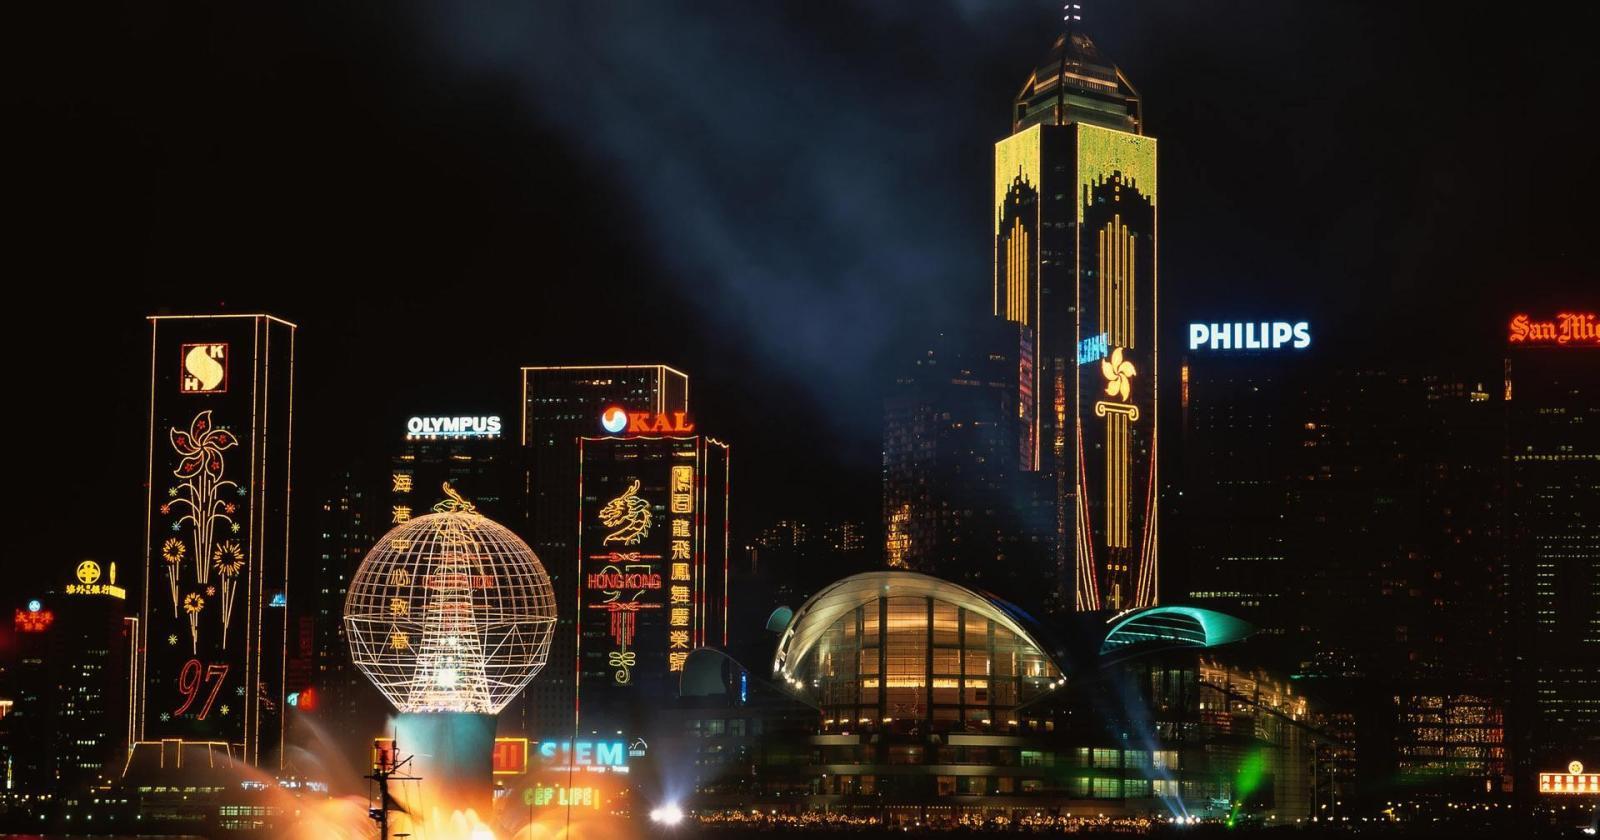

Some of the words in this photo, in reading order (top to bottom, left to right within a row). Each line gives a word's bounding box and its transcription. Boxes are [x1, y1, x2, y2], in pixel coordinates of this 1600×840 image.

[1190, 322, 1311, 350] PHILIPS
[1510, 314, 1557, 343] San
[407, 415, 502, 433] OLYMPUS
[628, 411, 695, 433] KAL
[587, 573, 625, 589] HONG
[625, 573, 662, 589] KONG
[173, 658, 230, 721] 97
[559, 787, 593, 806] LIFE
